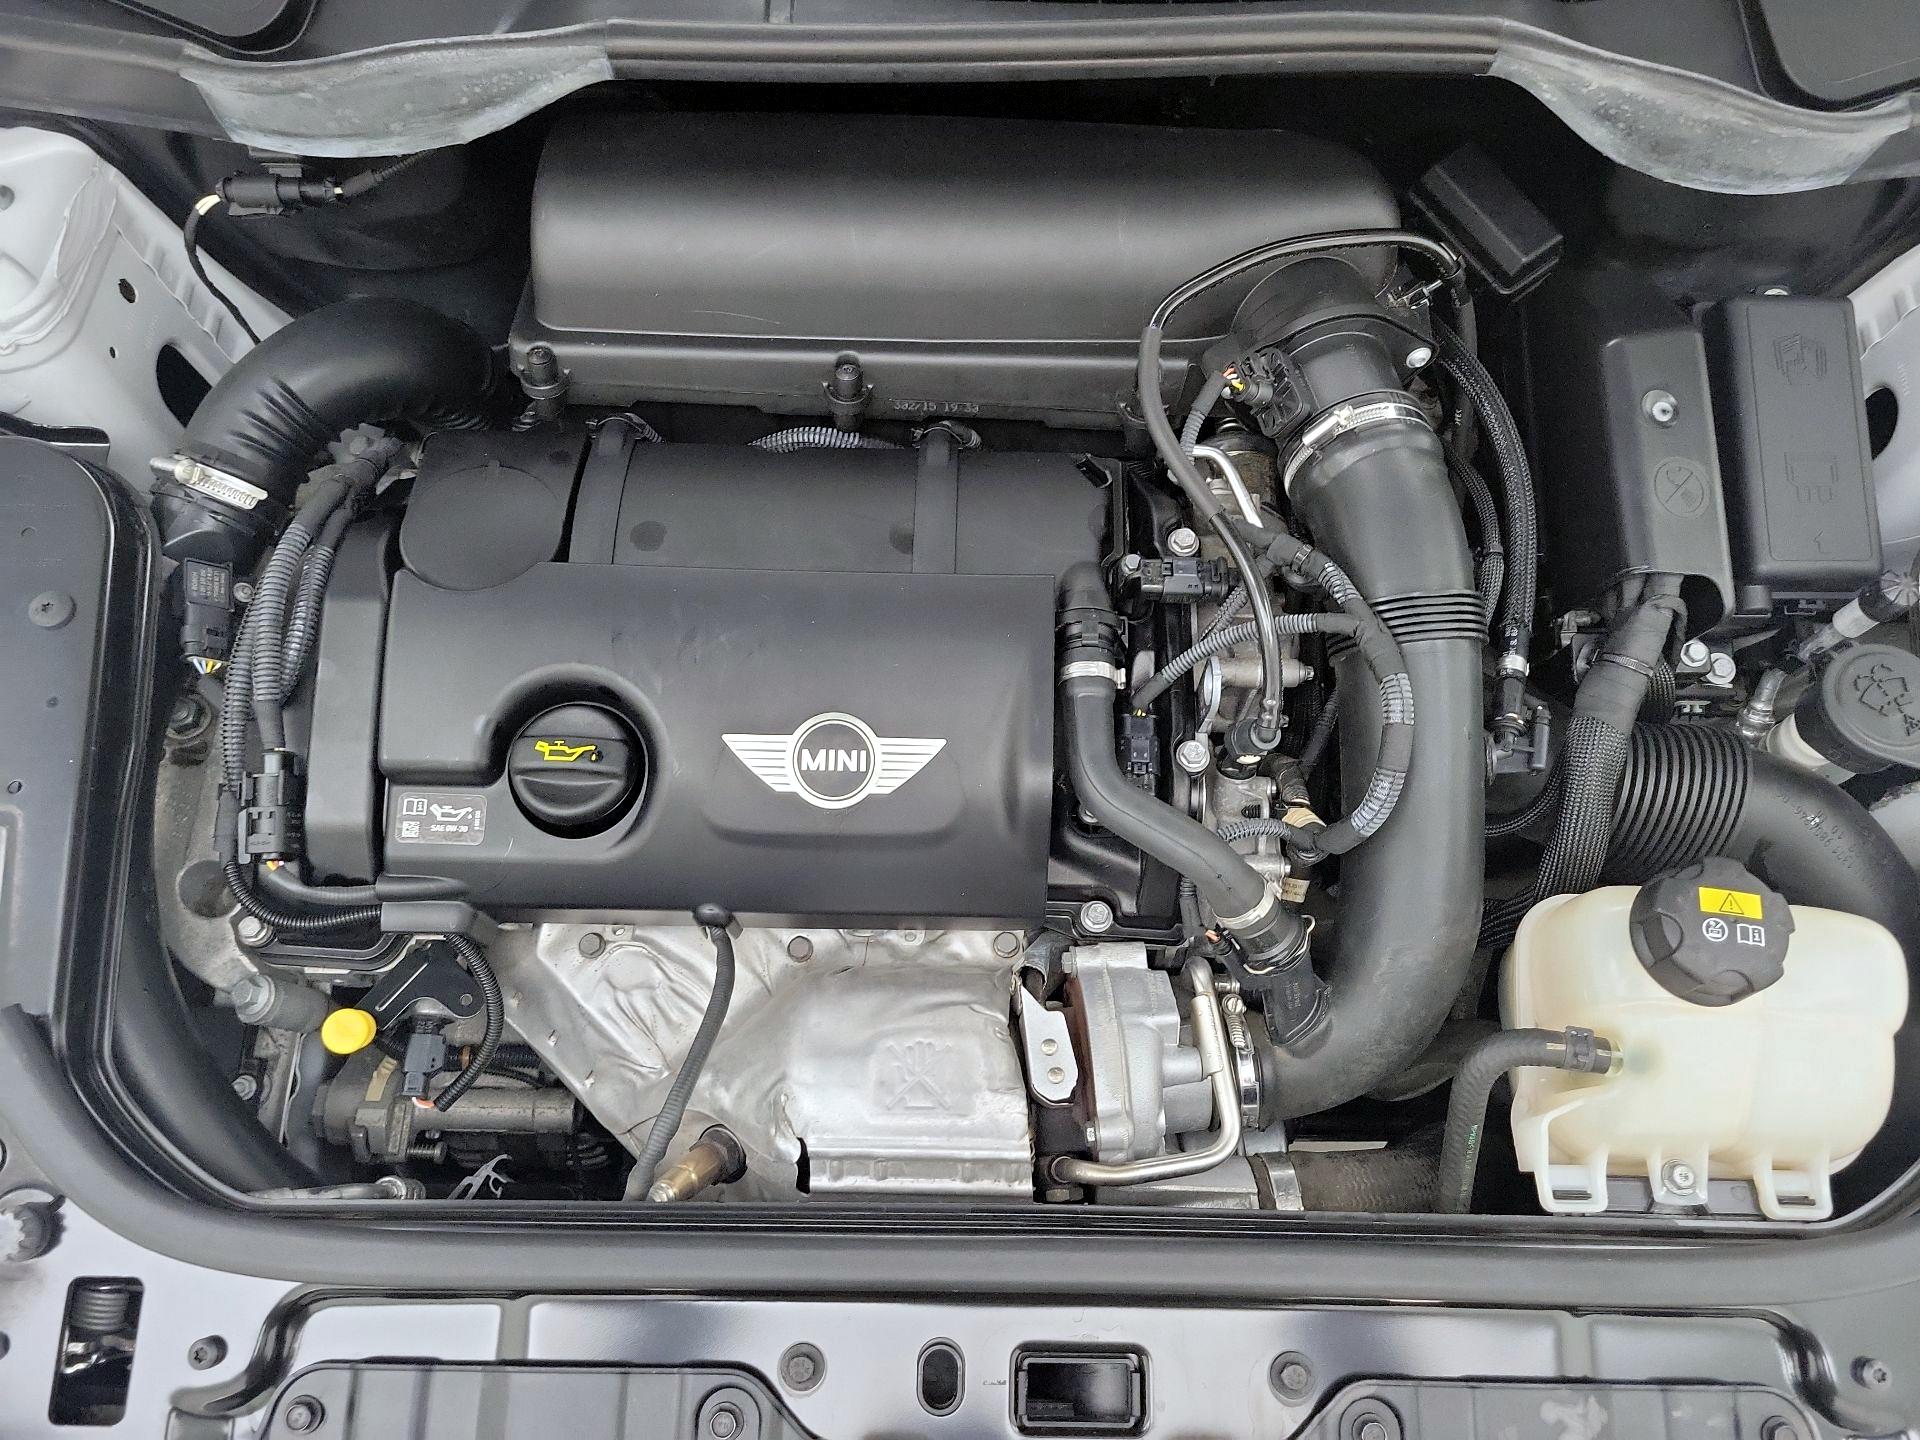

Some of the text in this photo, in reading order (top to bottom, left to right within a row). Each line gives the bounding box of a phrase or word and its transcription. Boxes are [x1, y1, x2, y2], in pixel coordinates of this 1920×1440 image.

[800, 747, 867, 772] MINI
[430, 824, 469, 833] SAE 0W-30
